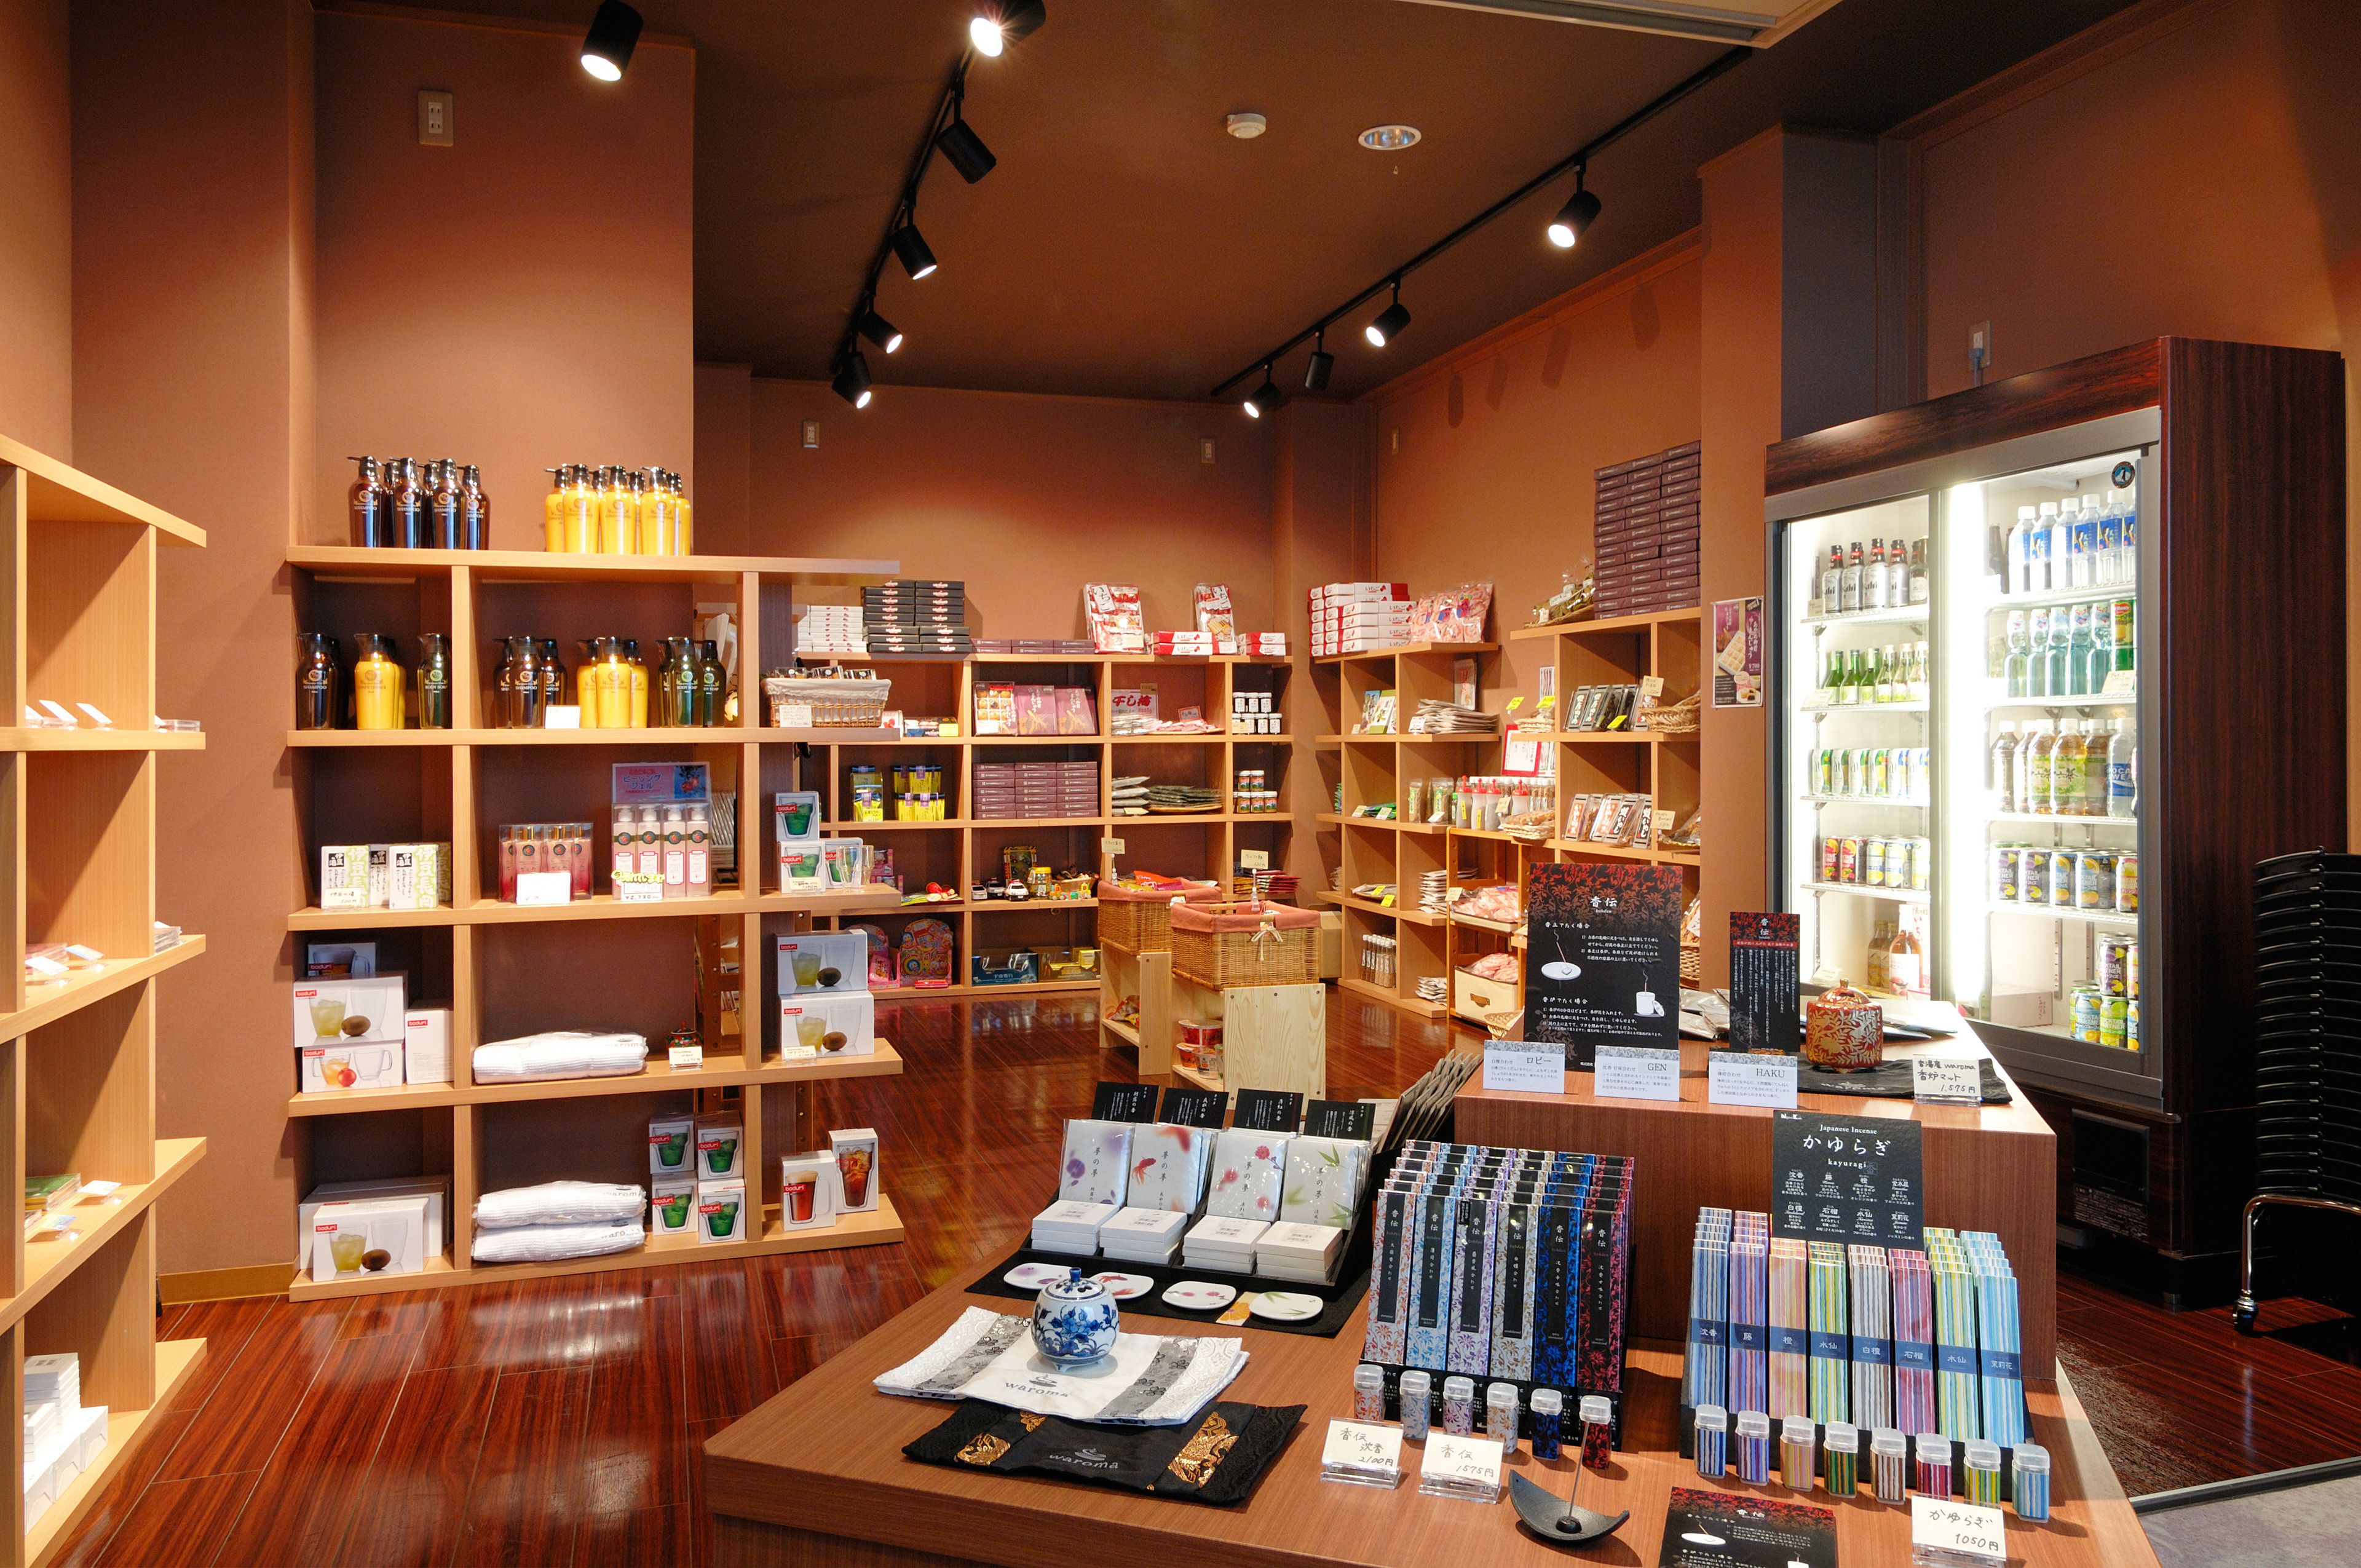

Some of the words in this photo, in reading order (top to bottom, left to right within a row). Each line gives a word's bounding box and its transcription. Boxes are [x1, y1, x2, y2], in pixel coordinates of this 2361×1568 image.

[1094, 587, 1110, 611] いちご
[1214, 587, 1230, 611] いちご
[1590, 895, 1618, 908] 香伝
[1647, 1063, 1667, 1071] GEN
[1756, 1068, 1786, 1078] HAKU
[1917, 1069, 1961, 1082] 香炉マット
[1819, 1124, 1849, 1133] Japanese
[1803, 1134, 1891, 1156] かゆらぎ
[1091, 1147, 1101, 1178] 夢の夢
[1828, 1158, 1867, 1169] kayuragi
[1315, 1168, 1324, 1199] 夢の夢
[1391, 1210, 1399, 1227] 香伝
[1430, 1213, 1439, 1230] 香伝
[1472, 1218, 1481, 1235] 香伝
[1513, 1222, 1522, 1240] 香伝
[1555, 1224, 1564, 1243] 香伝
[1598, 1229, 1606, 1247] 香伝
[1699, 1328, 1717, 1337] 沈香
[1743, 1332, 1752, 1341] 藤
[1783, 1336, 1793, 1345] 橙
[1862, 1346, 1881, 1355] 白檀
[1904, 1350, 1923, 1360] 石榴
[1990, 1361, 2012, 1370] 茉莉花
[1005, 1382, 1069, 1398] waroma
[1340, 1427, 1367, 1443] 香伝
[1441, 1444, 1473, 1461] 香伝
[1049, 1454, 1119, 1470] waroma
[1358, 1455, 1393, 1467] 2100円
[1456, 1465, 1494, 1478] 1575円
[1929, 1508, 1993, 1529] かゆらぎ
[1955, 1533, 1999, 1551] 1050円
